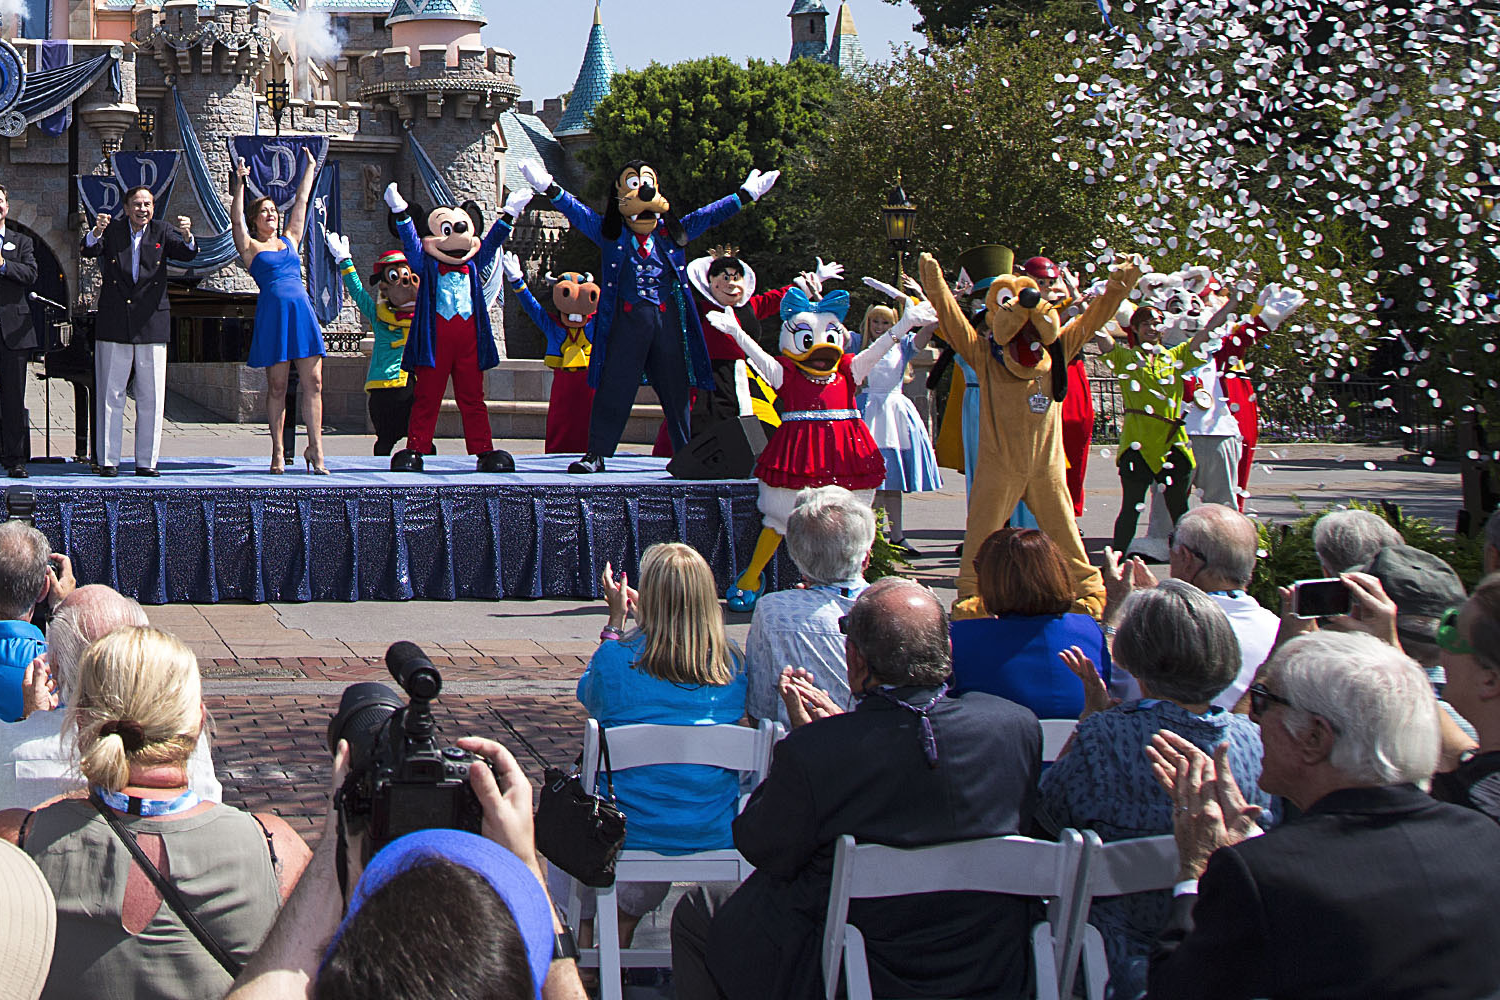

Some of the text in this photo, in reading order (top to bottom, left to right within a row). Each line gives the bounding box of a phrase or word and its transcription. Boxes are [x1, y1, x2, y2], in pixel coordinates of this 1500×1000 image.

[135, 157, 158, 188] D
[263, 144, 296, 187] D
[99, 181, 120, 210] D
